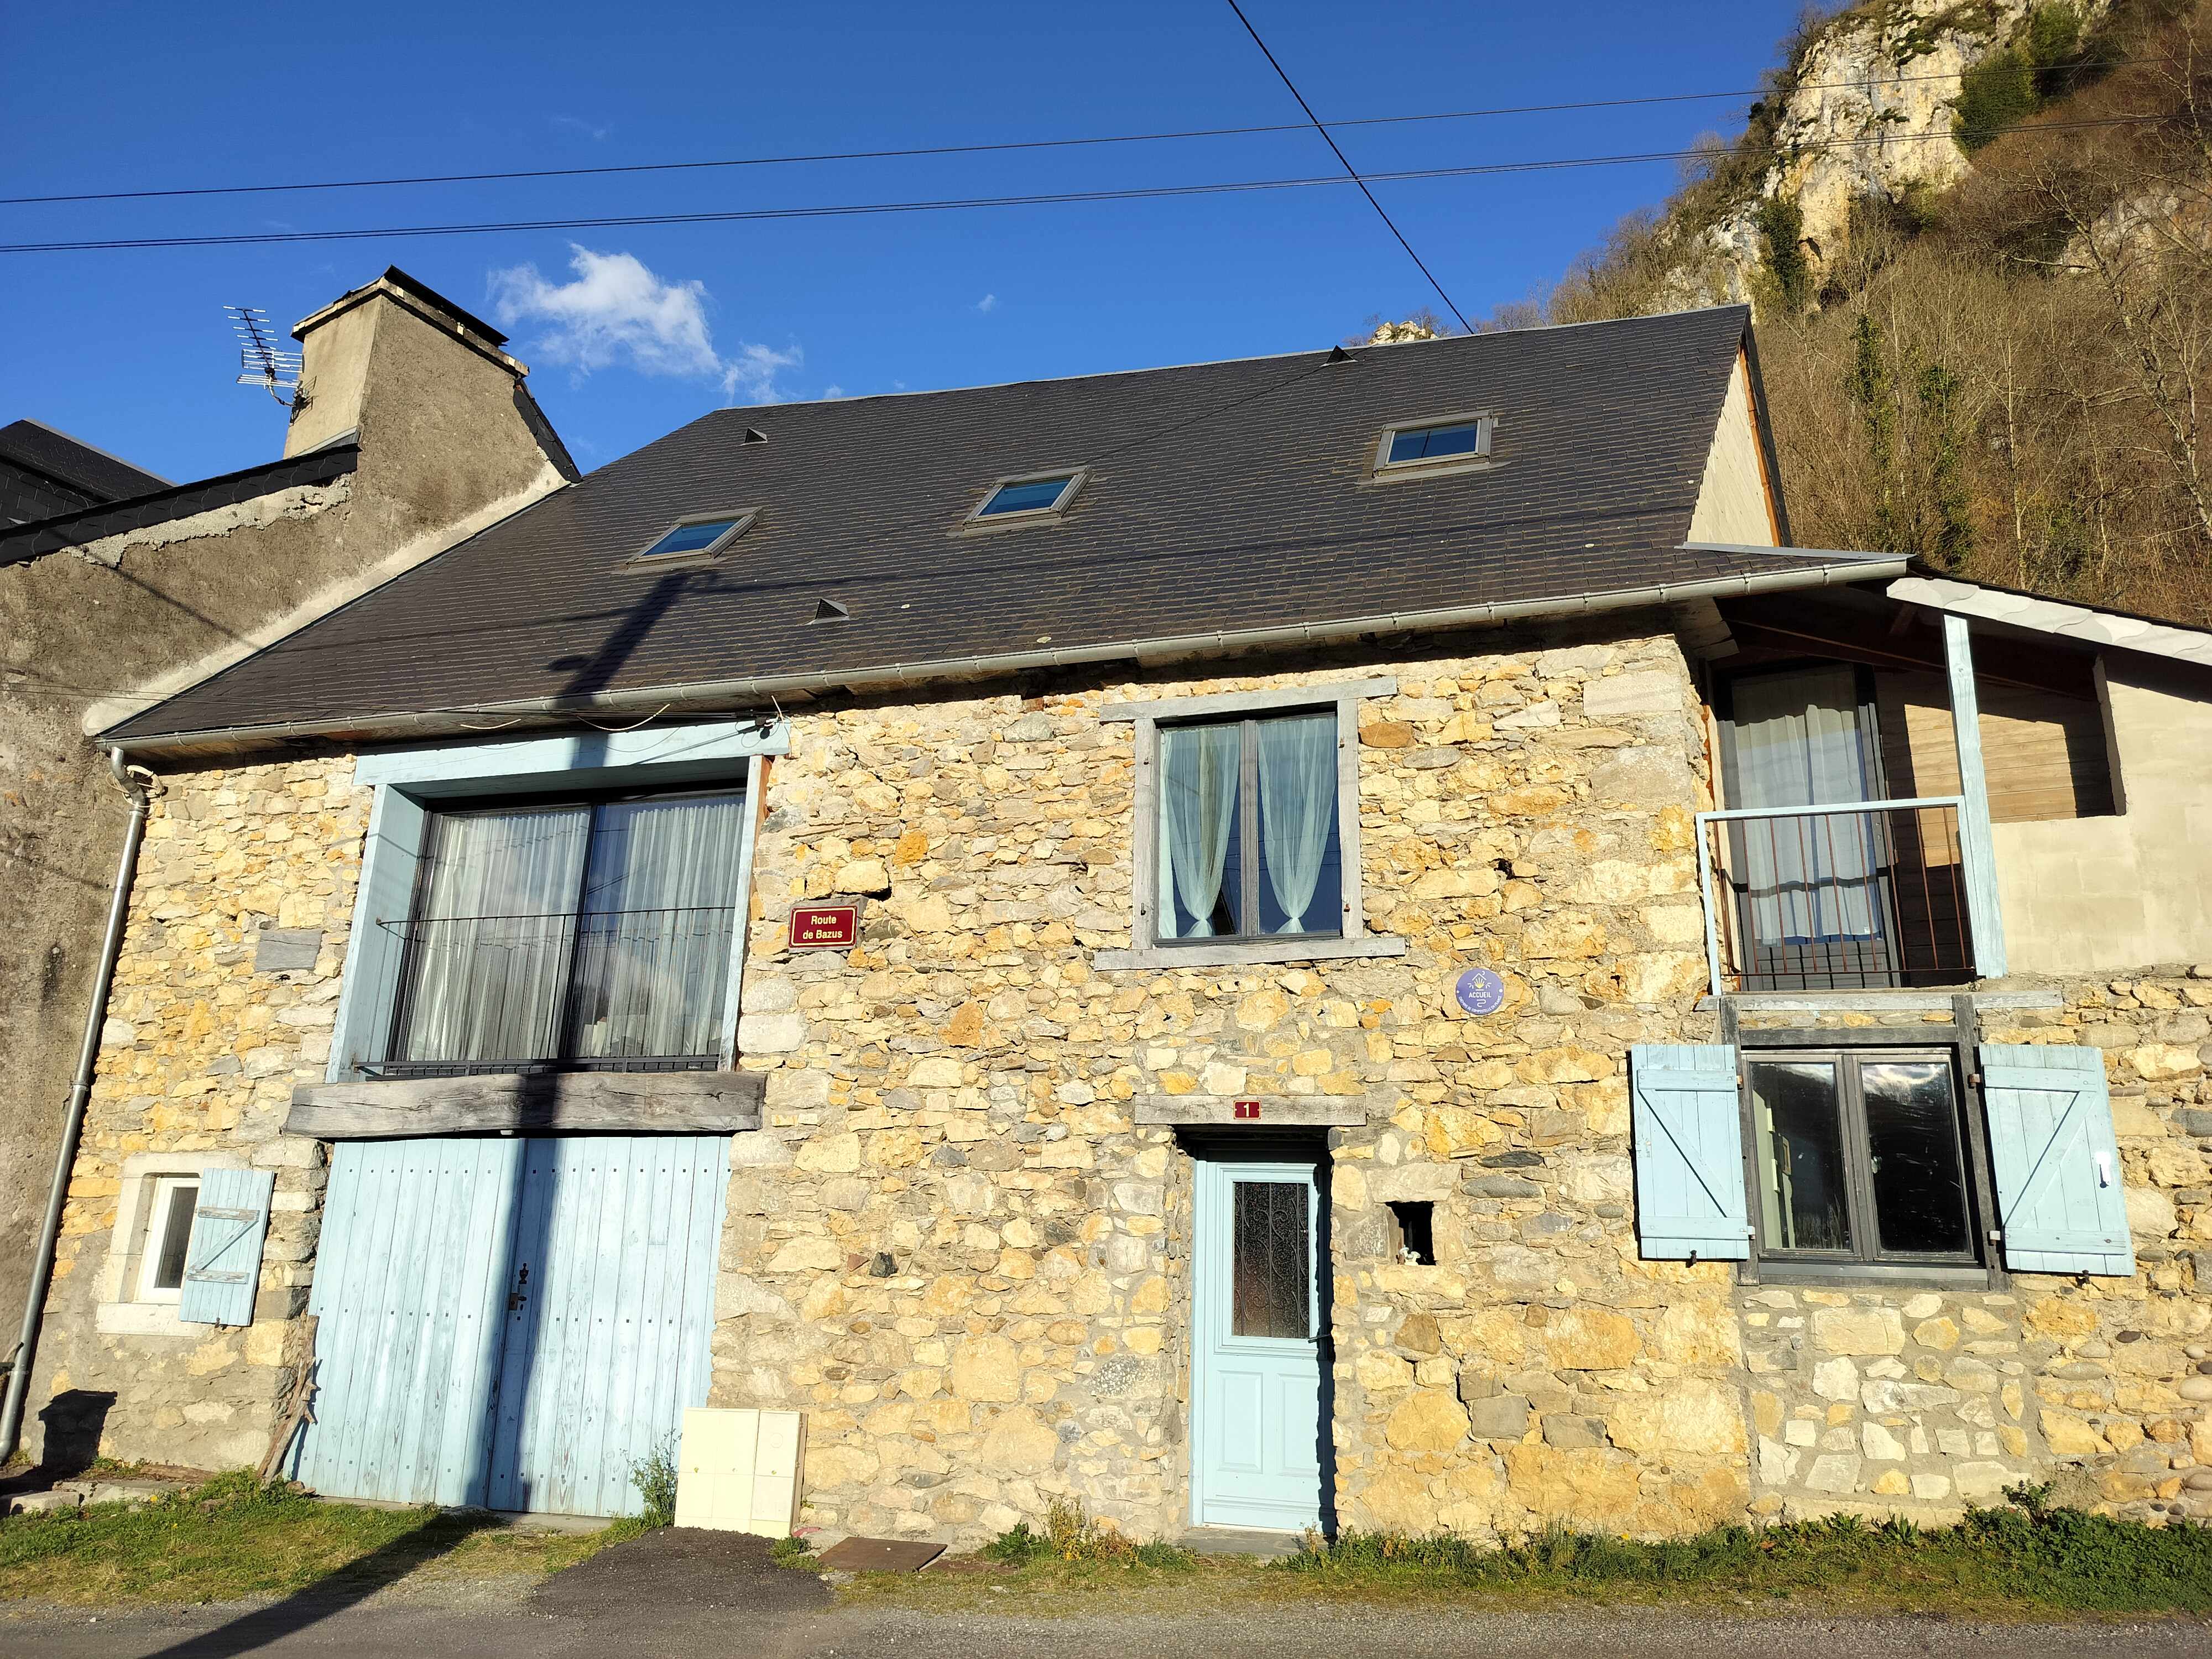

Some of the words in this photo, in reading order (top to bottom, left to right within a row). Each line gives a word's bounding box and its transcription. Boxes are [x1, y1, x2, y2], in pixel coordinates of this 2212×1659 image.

[811, 915, 837, 925] Route
[802, 930, 813, 940] de
[816, 929, 843, 939] Bazus
[1243, 1103, 1249, 1117] 1
